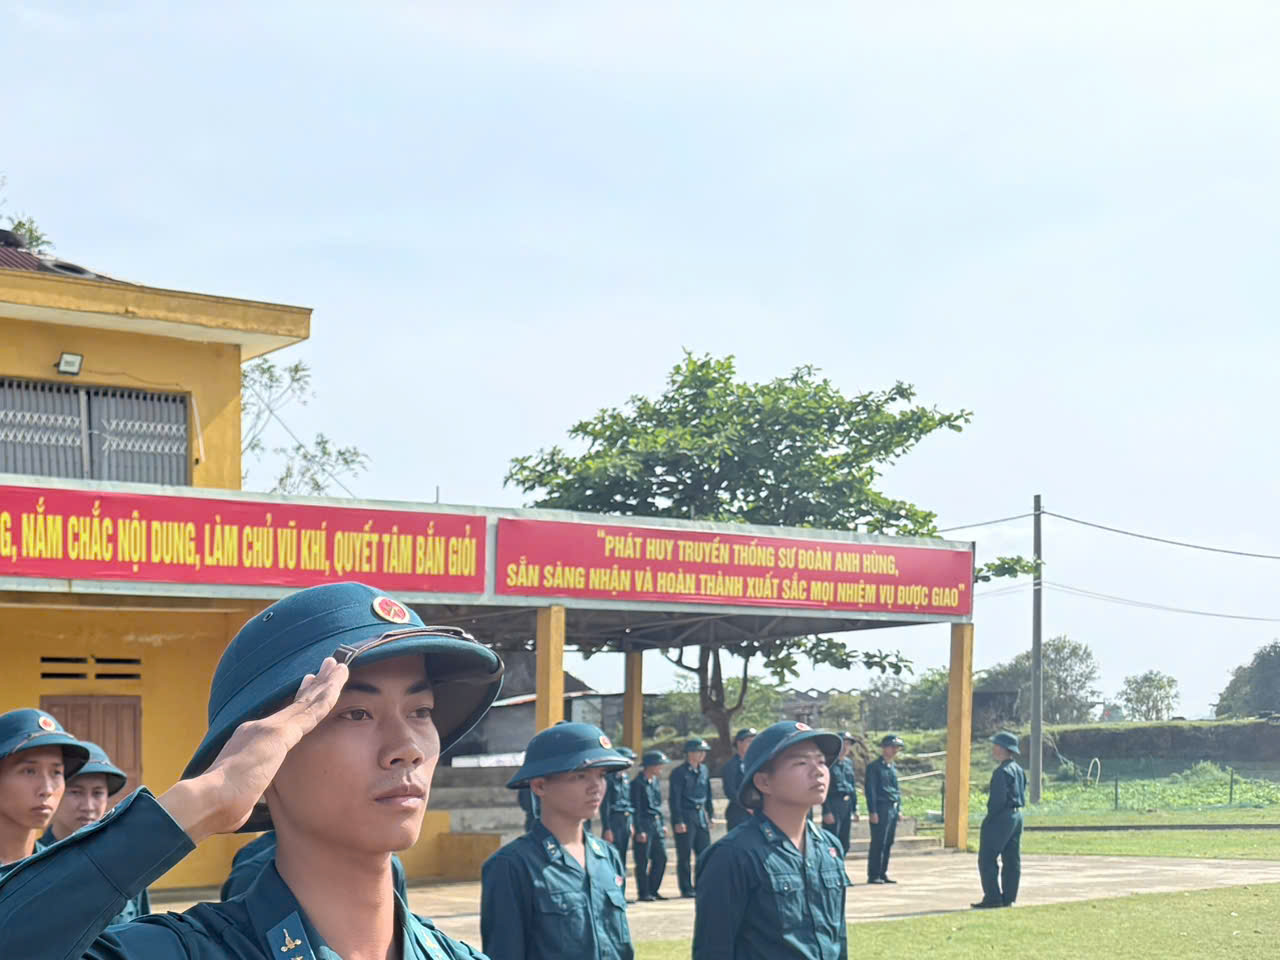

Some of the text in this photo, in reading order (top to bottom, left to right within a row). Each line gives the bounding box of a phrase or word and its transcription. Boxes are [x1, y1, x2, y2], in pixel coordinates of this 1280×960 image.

[22, 496, 63, 559] NẮM
[67, 500, 113, 560] CHẮC
[117, 510, 147, 573] NỘI
[151, 520, 200, 570] DUNG,
[204, 514, 239, 567] LÀM
[242, 513, 274, 568] CHỦ
[277, 520, 297, 569] VŨ
[301, 521, 330, 575] KHÍ,
[334, 520, 380, 576] QUYẾT
[381, 525, 413, 574] TÂM
[416, 521, 446, 575] BẮN
[448, 525, 477, 576] GIỎI
